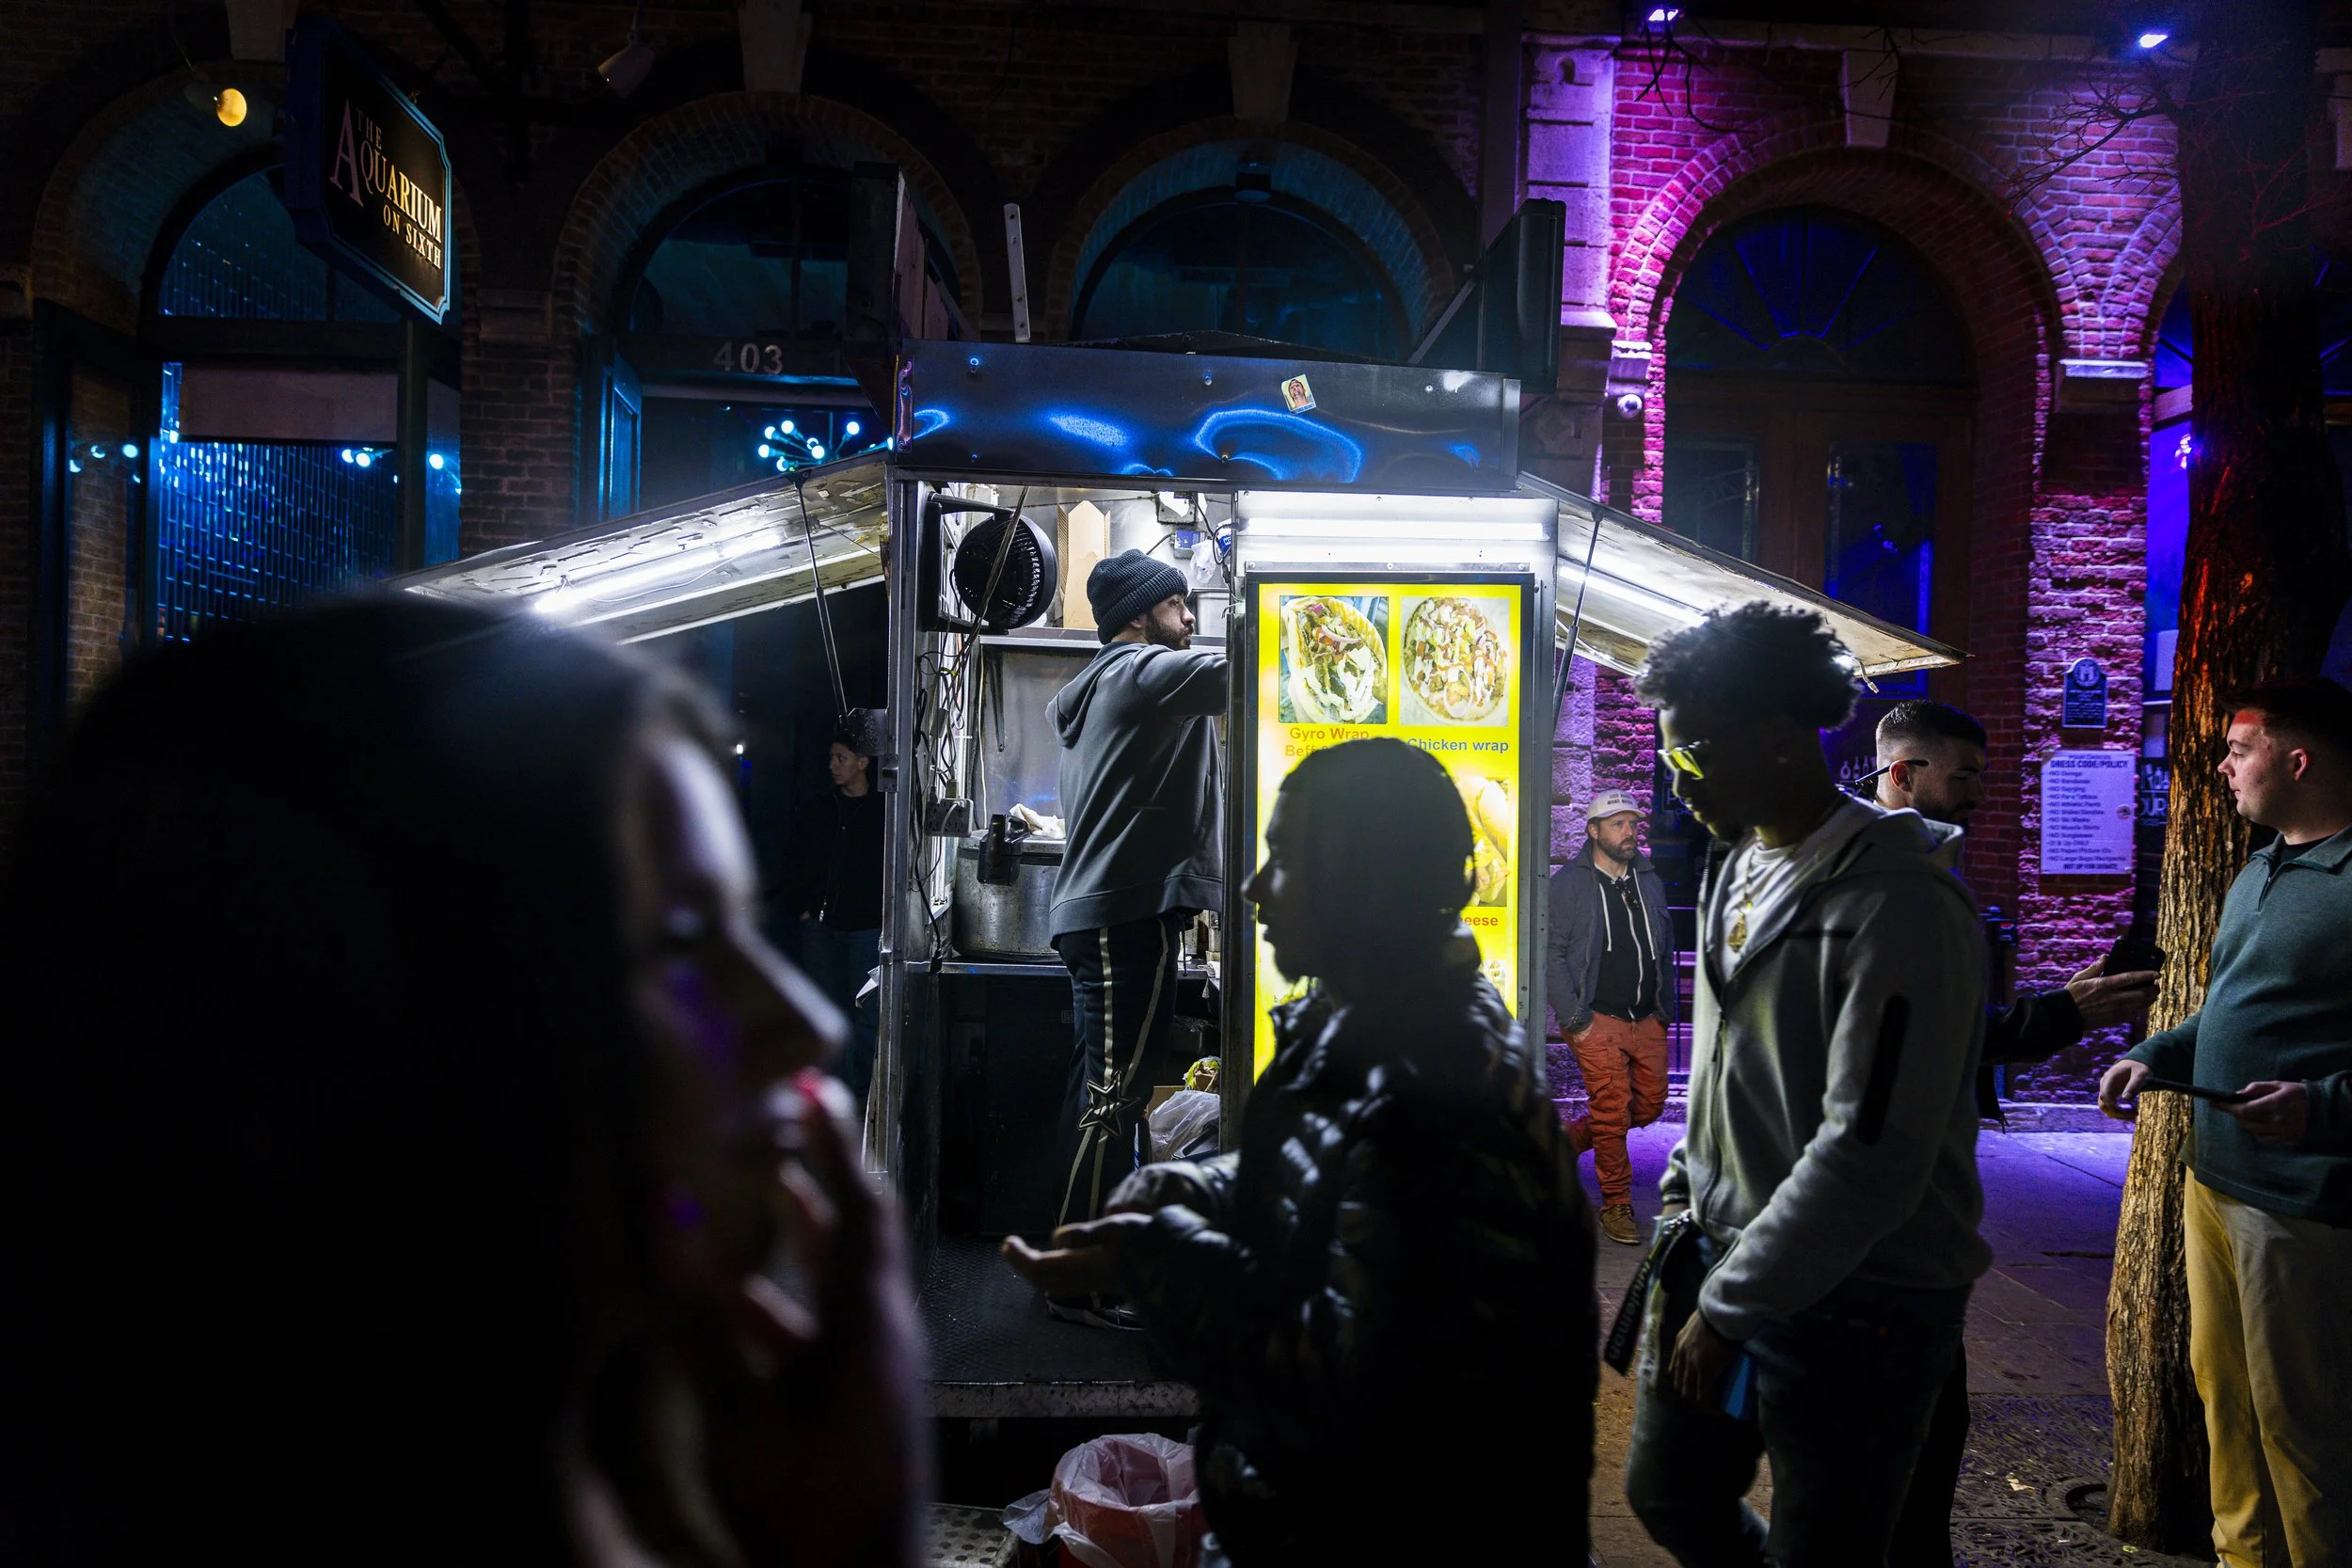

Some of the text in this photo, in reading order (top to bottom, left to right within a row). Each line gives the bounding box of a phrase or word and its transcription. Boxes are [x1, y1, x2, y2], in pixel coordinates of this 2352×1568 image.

[356, 107, 383, 150] THE
[329, 98, 442, 245] AQUARIUM
[383, 204, 441, 270] ON SIXTH
[713, 341, 784, 375] 403
[1290, 727, 1369, 742] Gyro Wrap
[1407, 737, 1509, 753] Chicken wrap
[2050, 760, 2075, 768] DRESS
[1460, 916, 1499, 927] eese
